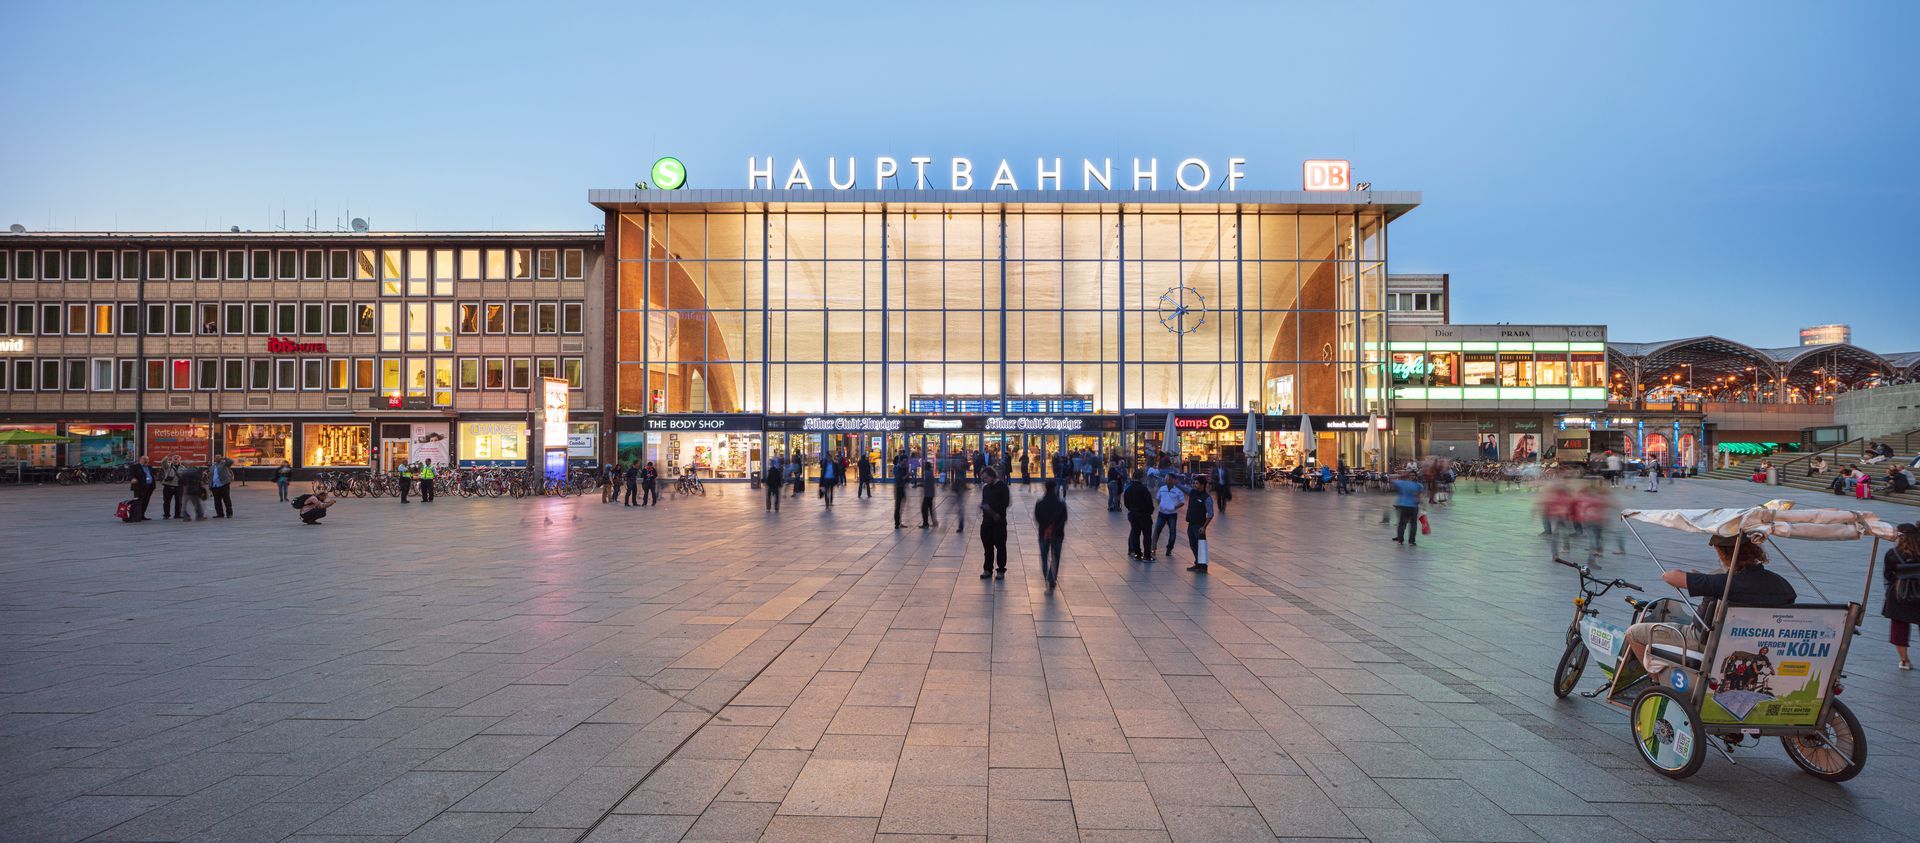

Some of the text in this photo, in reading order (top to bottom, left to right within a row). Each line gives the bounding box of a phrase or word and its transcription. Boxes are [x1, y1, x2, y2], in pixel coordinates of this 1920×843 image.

[657, 160, 678, 187] S
[748, 157, 1246, 190] HAUPTBAHNHOF
[1309, 164, 1344, 186] DB
[0, 338, 24, 351] vid
[267, 337, 295, 352] ibis
[470, 424, 517, 435] CHANGE
[648, 420, 725, 429] THE BODY SHOP
[803, 417, 901, 430] Kölner Stadt-Anzeiger
[985, 417, 1082, 430] Kölner Stadt-Anzeiger
[1514, 421, 1537, 430] Douglas
[1730, 627, 1818, 639] RIKSCHA FAHRER
[1757, 641, 1787, 649] WERDEN
[1786, 639, 1831, 657] KÖLN
[1675, 672, 1684, 688] 3
